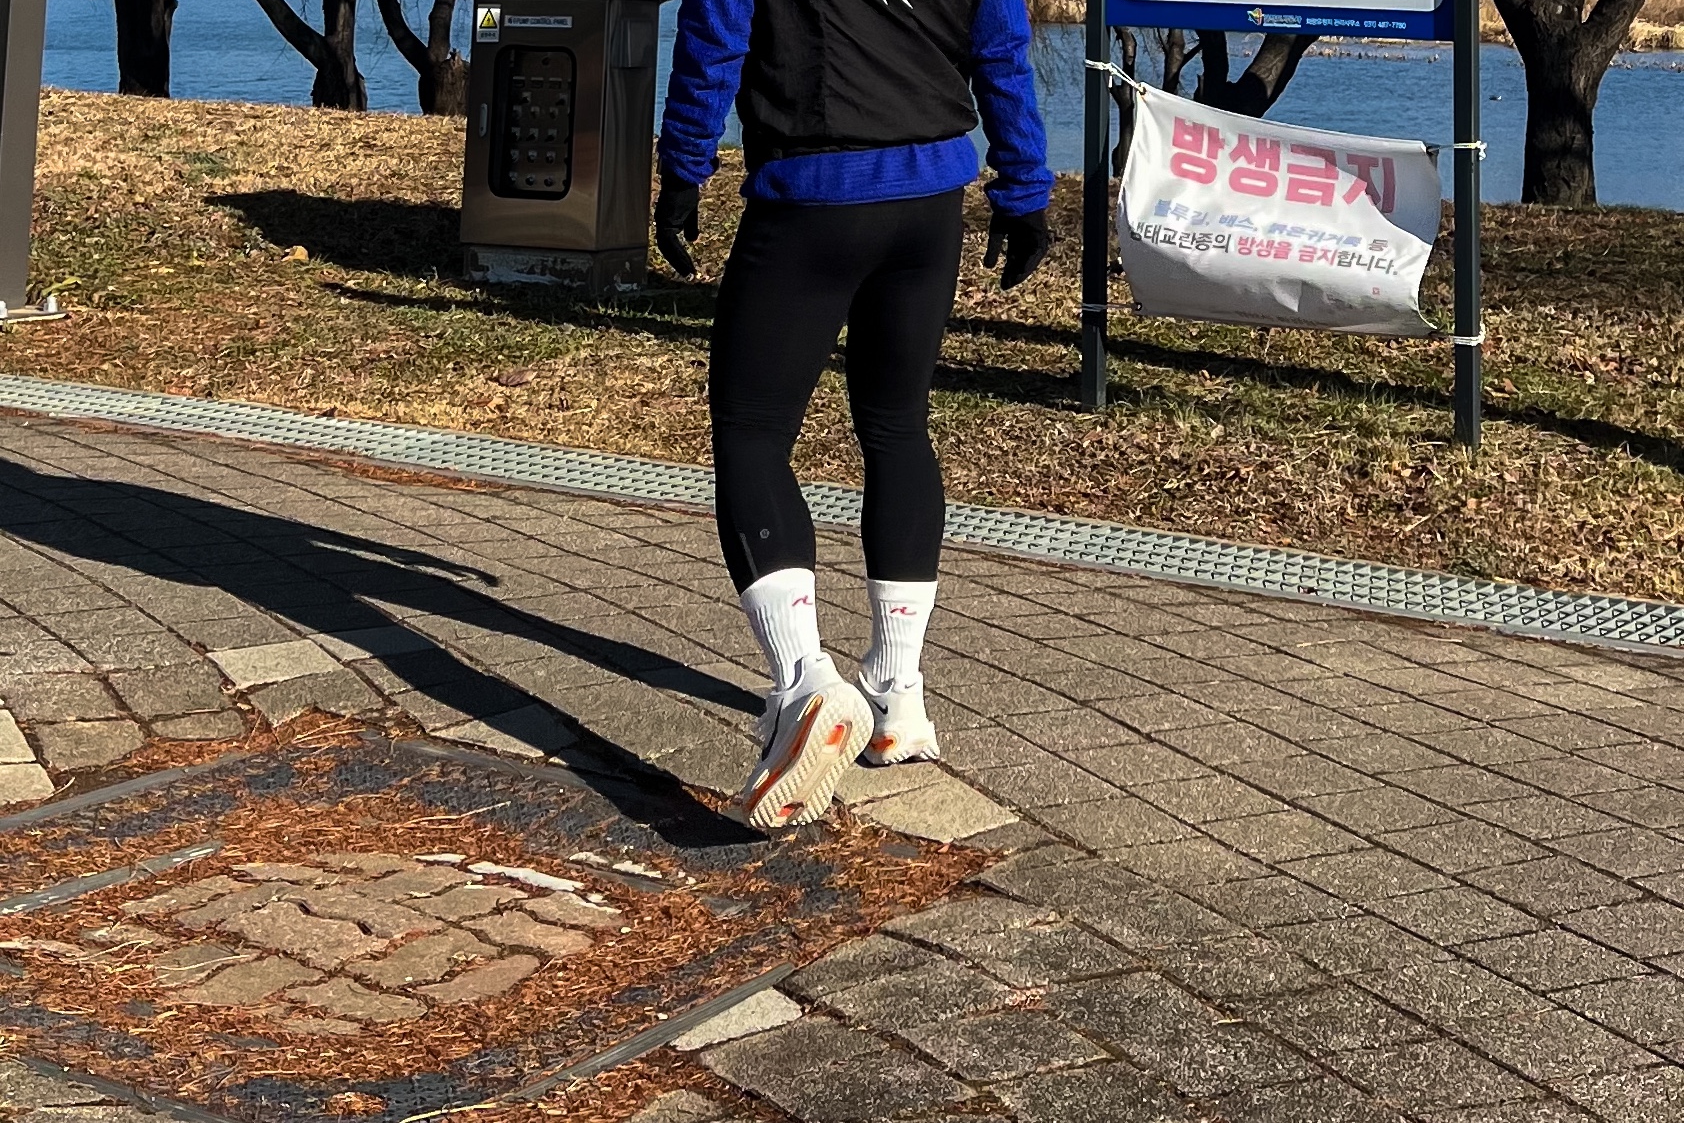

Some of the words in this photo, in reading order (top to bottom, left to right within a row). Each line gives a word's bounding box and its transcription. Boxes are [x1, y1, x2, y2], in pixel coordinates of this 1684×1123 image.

[1169, 115, 1396, 214] 방생금지
[1238, 236, 1292, 260] 방생을
[1298, 244, 1398, 275] 금지합니다.
